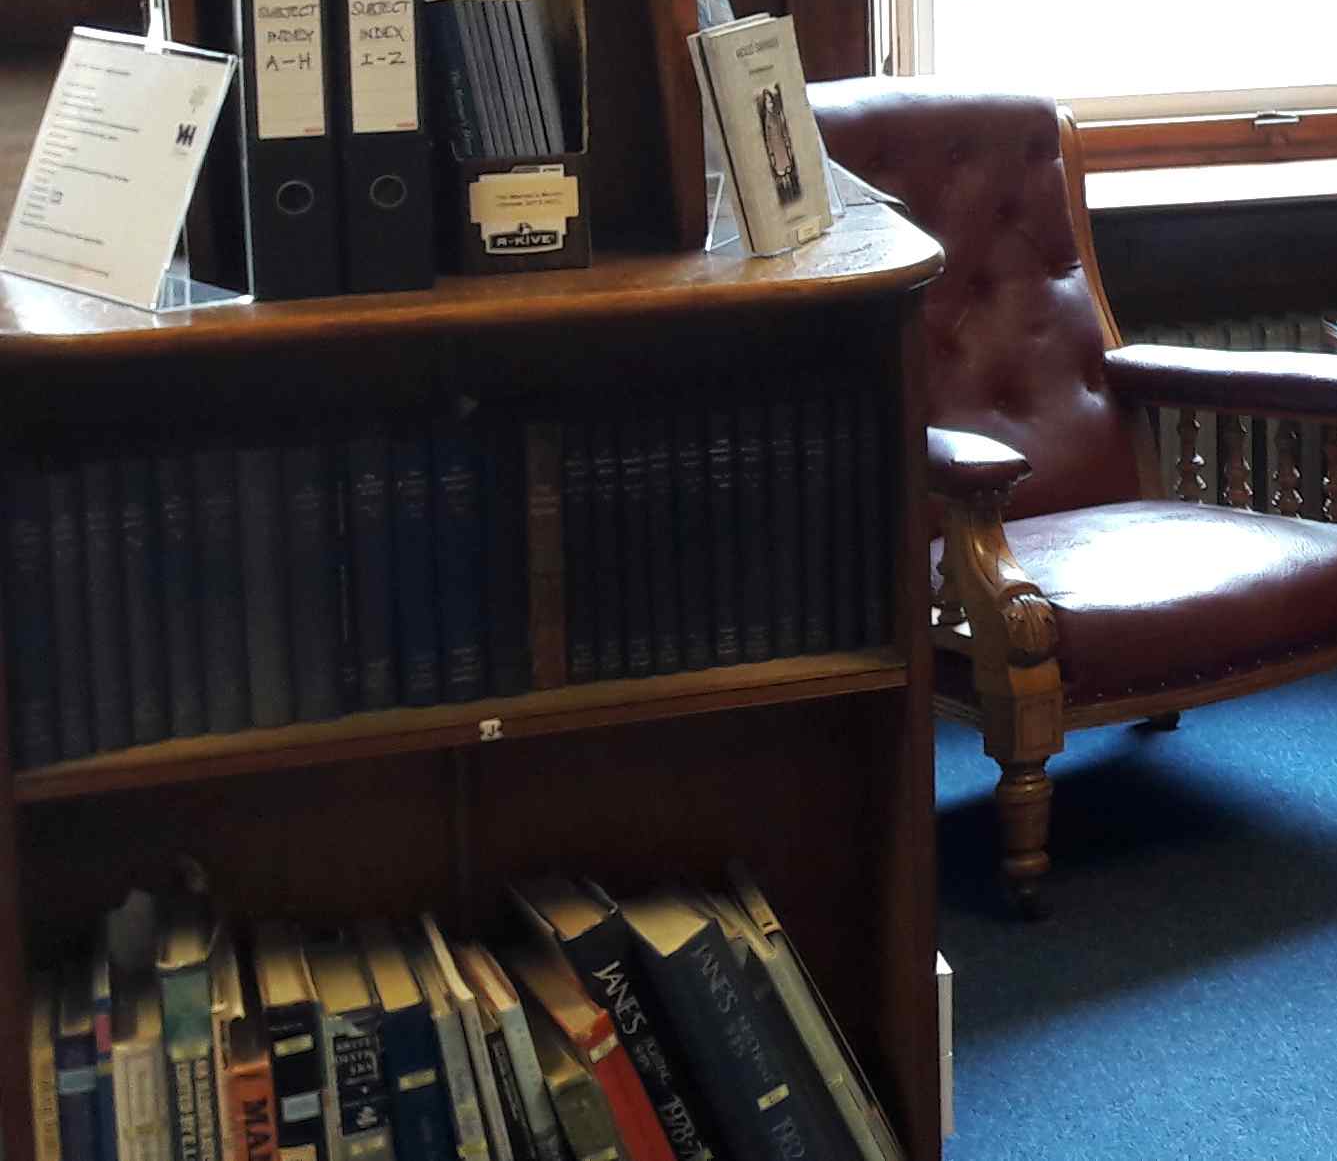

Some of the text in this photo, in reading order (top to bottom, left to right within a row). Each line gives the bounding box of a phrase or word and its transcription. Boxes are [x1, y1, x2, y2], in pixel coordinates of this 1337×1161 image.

[257, 3, 317, 19] SUBJECT
[351, 0, 411, 17] SUBJECT
[267, 28, 315, 44] INDEX
[360, 25, 406, 42] INDEX
[592, 959, 648, 1036] JANES
